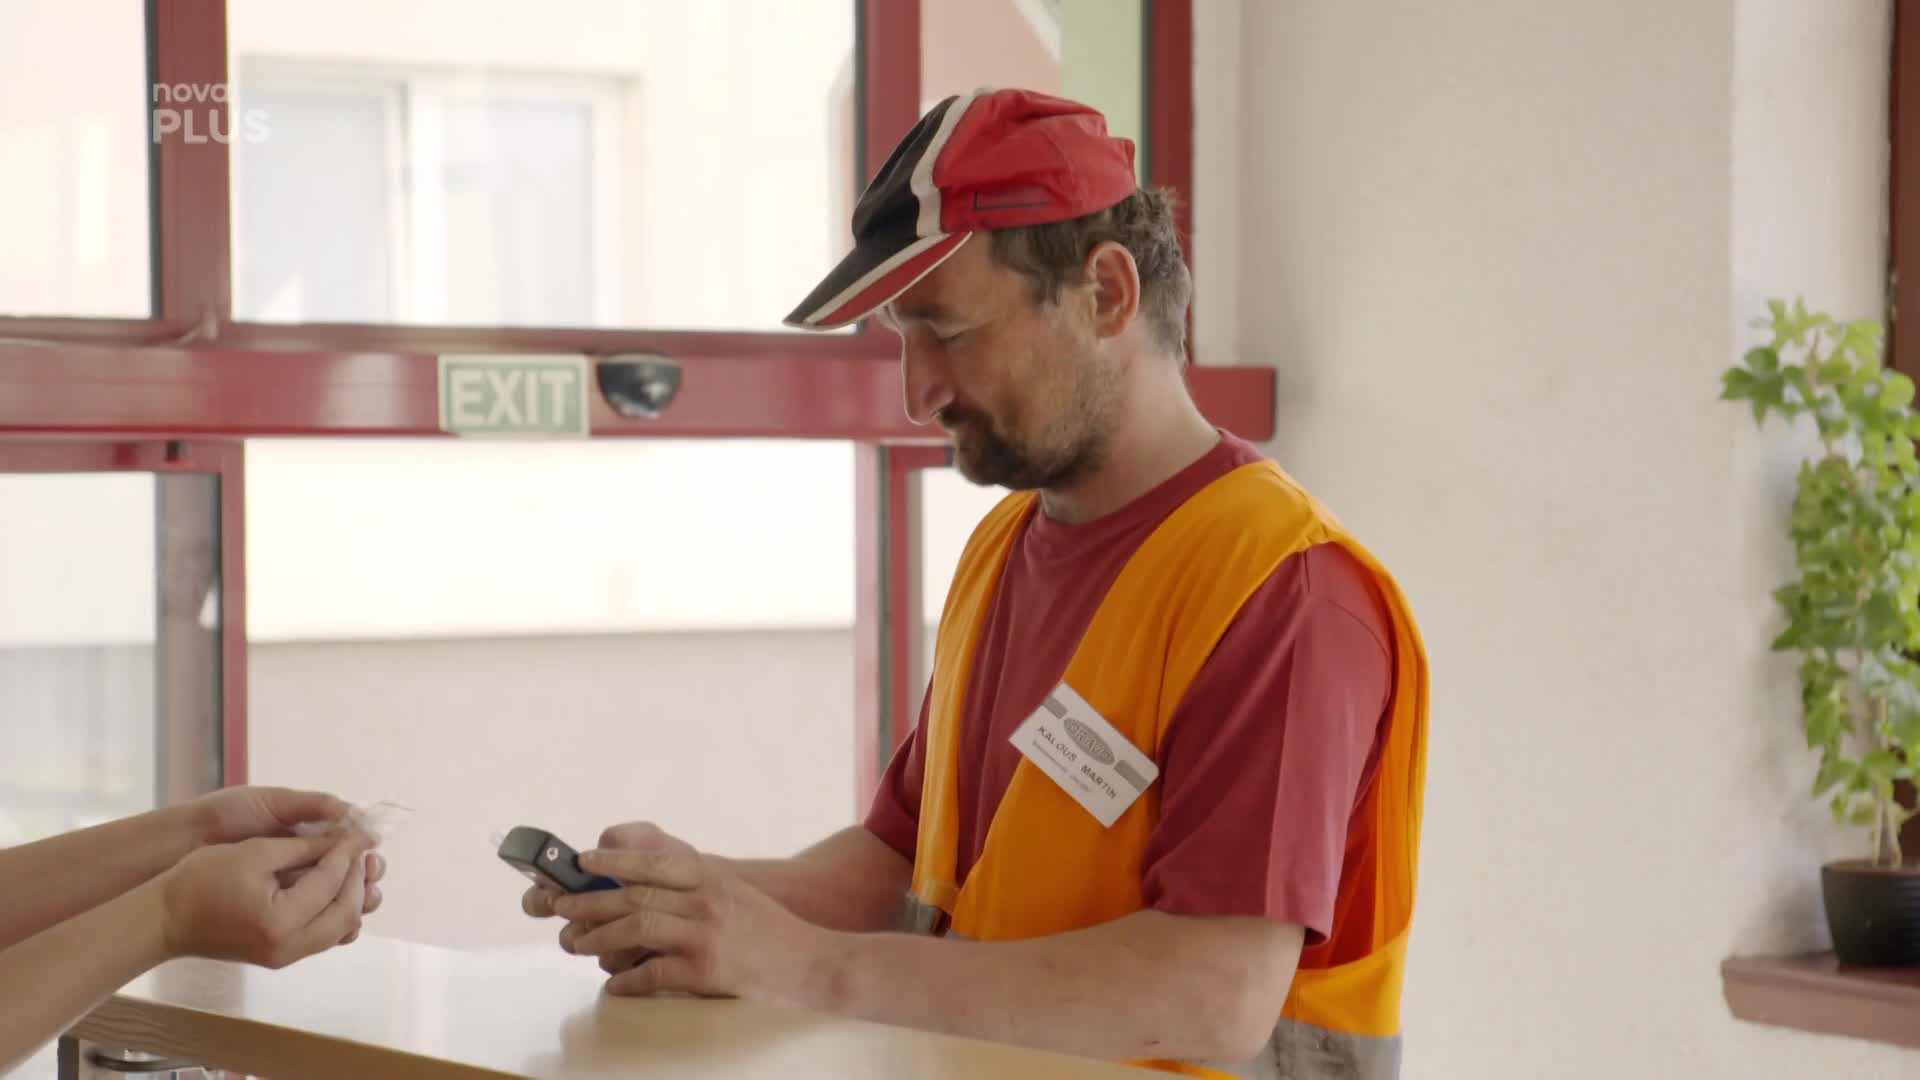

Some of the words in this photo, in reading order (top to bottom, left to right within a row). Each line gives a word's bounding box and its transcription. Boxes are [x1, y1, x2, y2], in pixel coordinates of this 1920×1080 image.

[450, 368, 576, 426] EXIT
[1037, 725, 1078, 762] KALOUS
[1080, 764, 1118, 800] MARTIN
